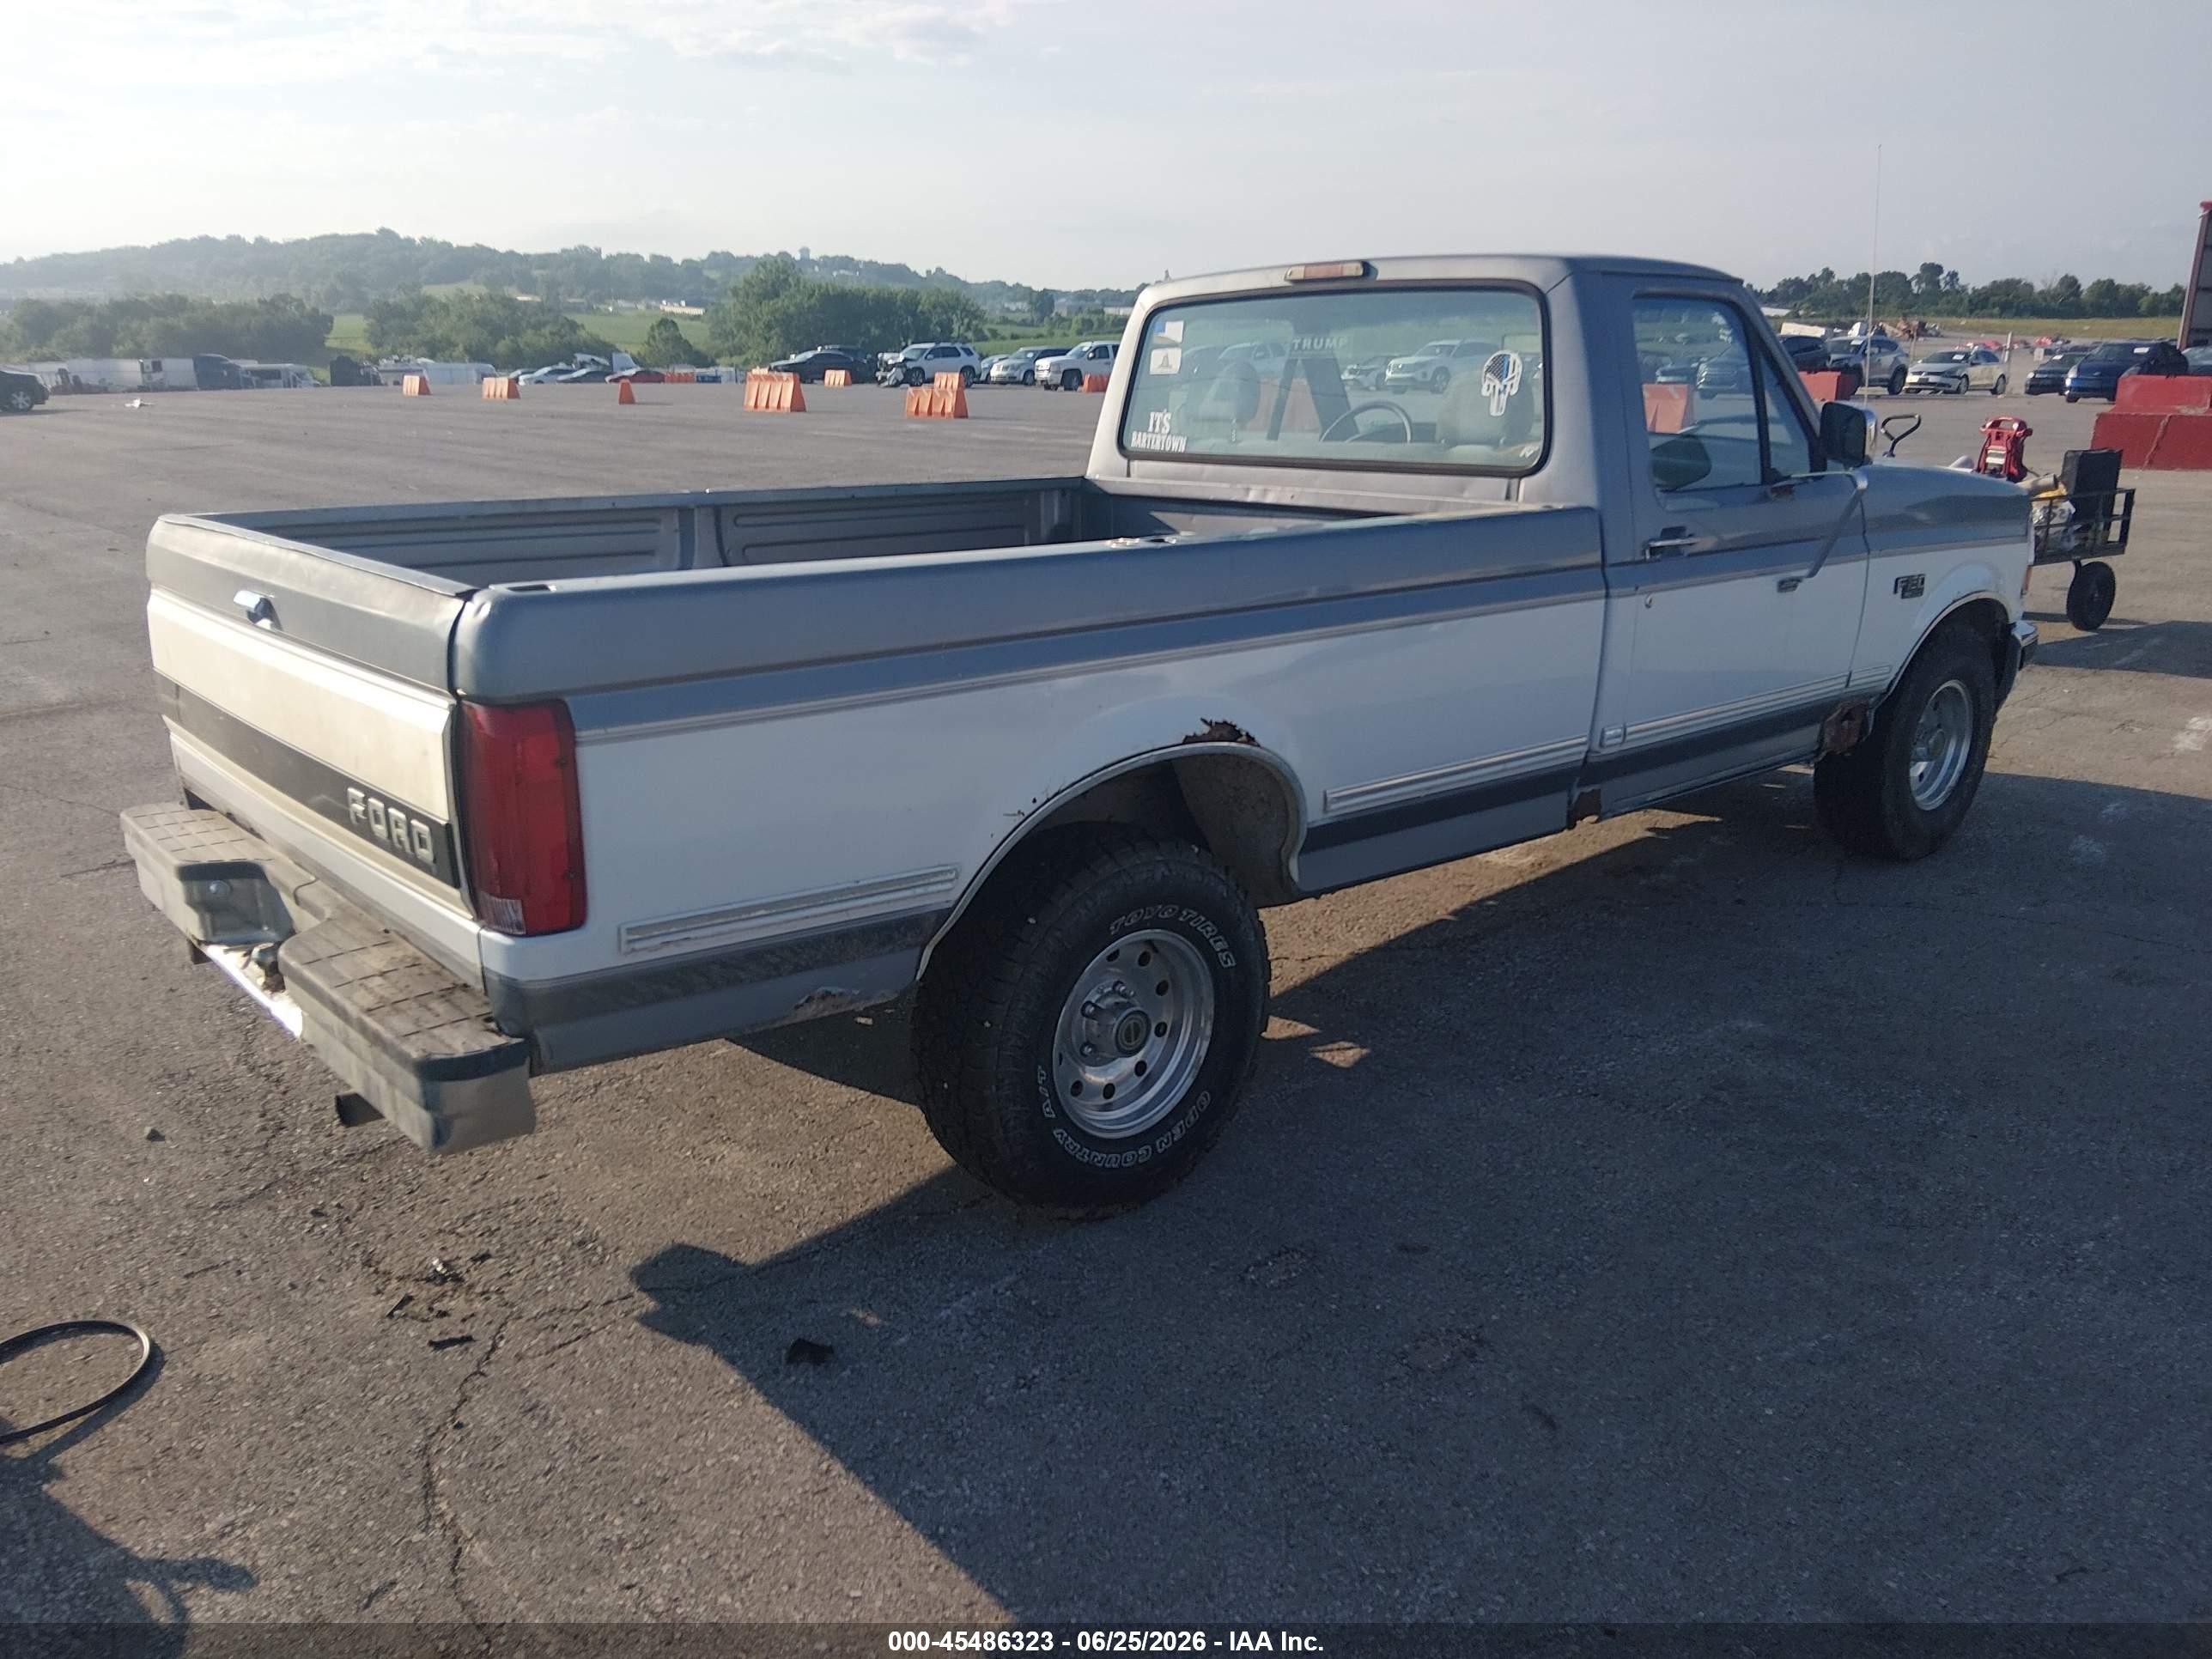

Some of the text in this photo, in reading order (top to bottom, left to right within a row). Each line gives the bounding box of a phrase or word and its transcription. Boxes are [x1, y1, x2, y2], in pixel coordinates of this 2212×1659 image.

[346, 787, 435, 866] FORD
[1109, 904, 1237, 969] TOYO TIRES
[1053, 1127, 1153, 1168] COUNTRY
[1155, 1091, 1211, 1153] OPEN
